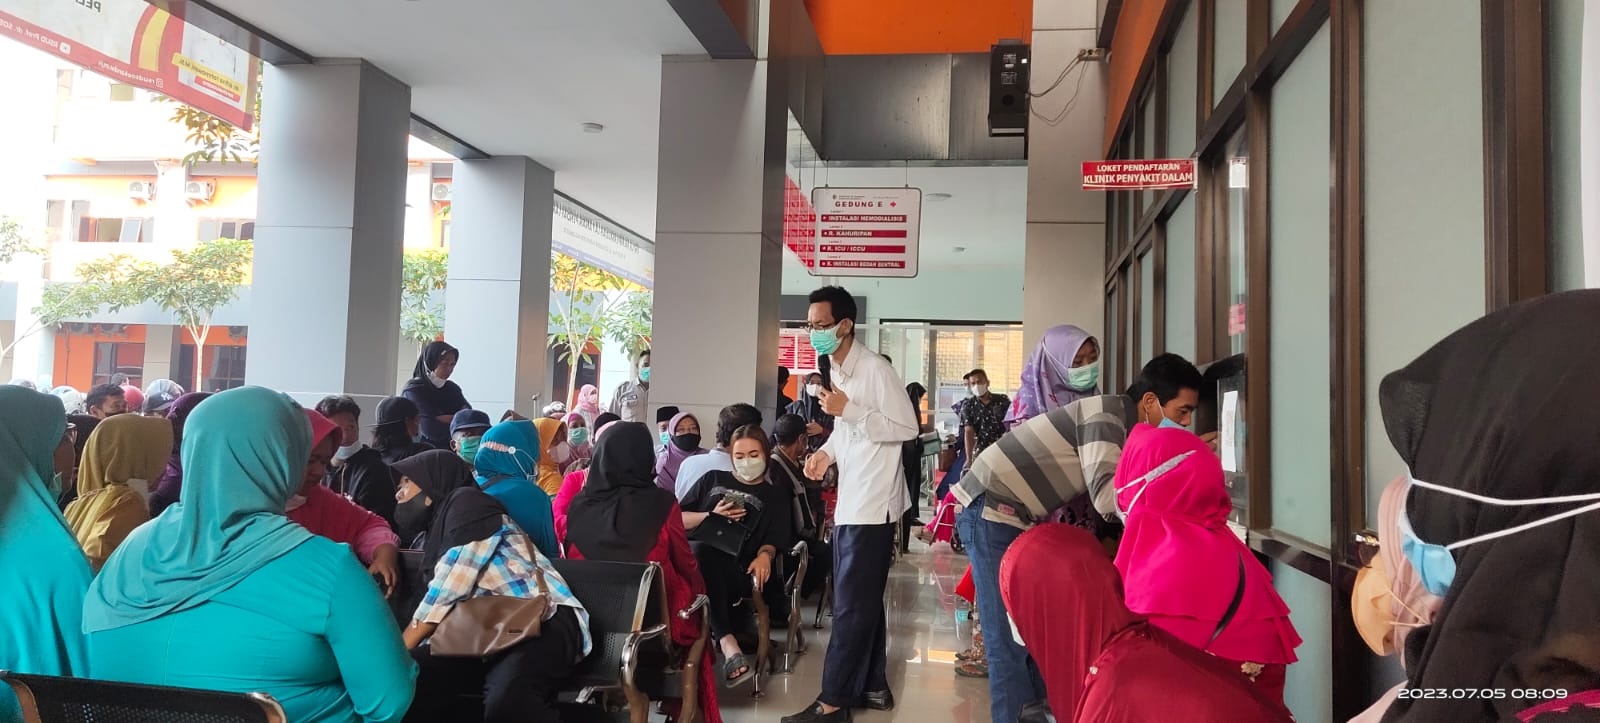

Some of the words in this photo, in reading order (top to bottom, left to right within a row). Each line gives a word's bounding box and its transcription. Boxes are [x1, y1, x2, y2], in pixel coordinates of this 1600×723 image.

[1097, 164, 1121, 172] LOKET
[1123, 163, 1180, 171] PENDAFTARAN
[1084, 174, 1115, 184] KLINIK
[1116, 173, 1161, 183] PENYAKIT
[1161, 172, 1193, 182] DALAM
